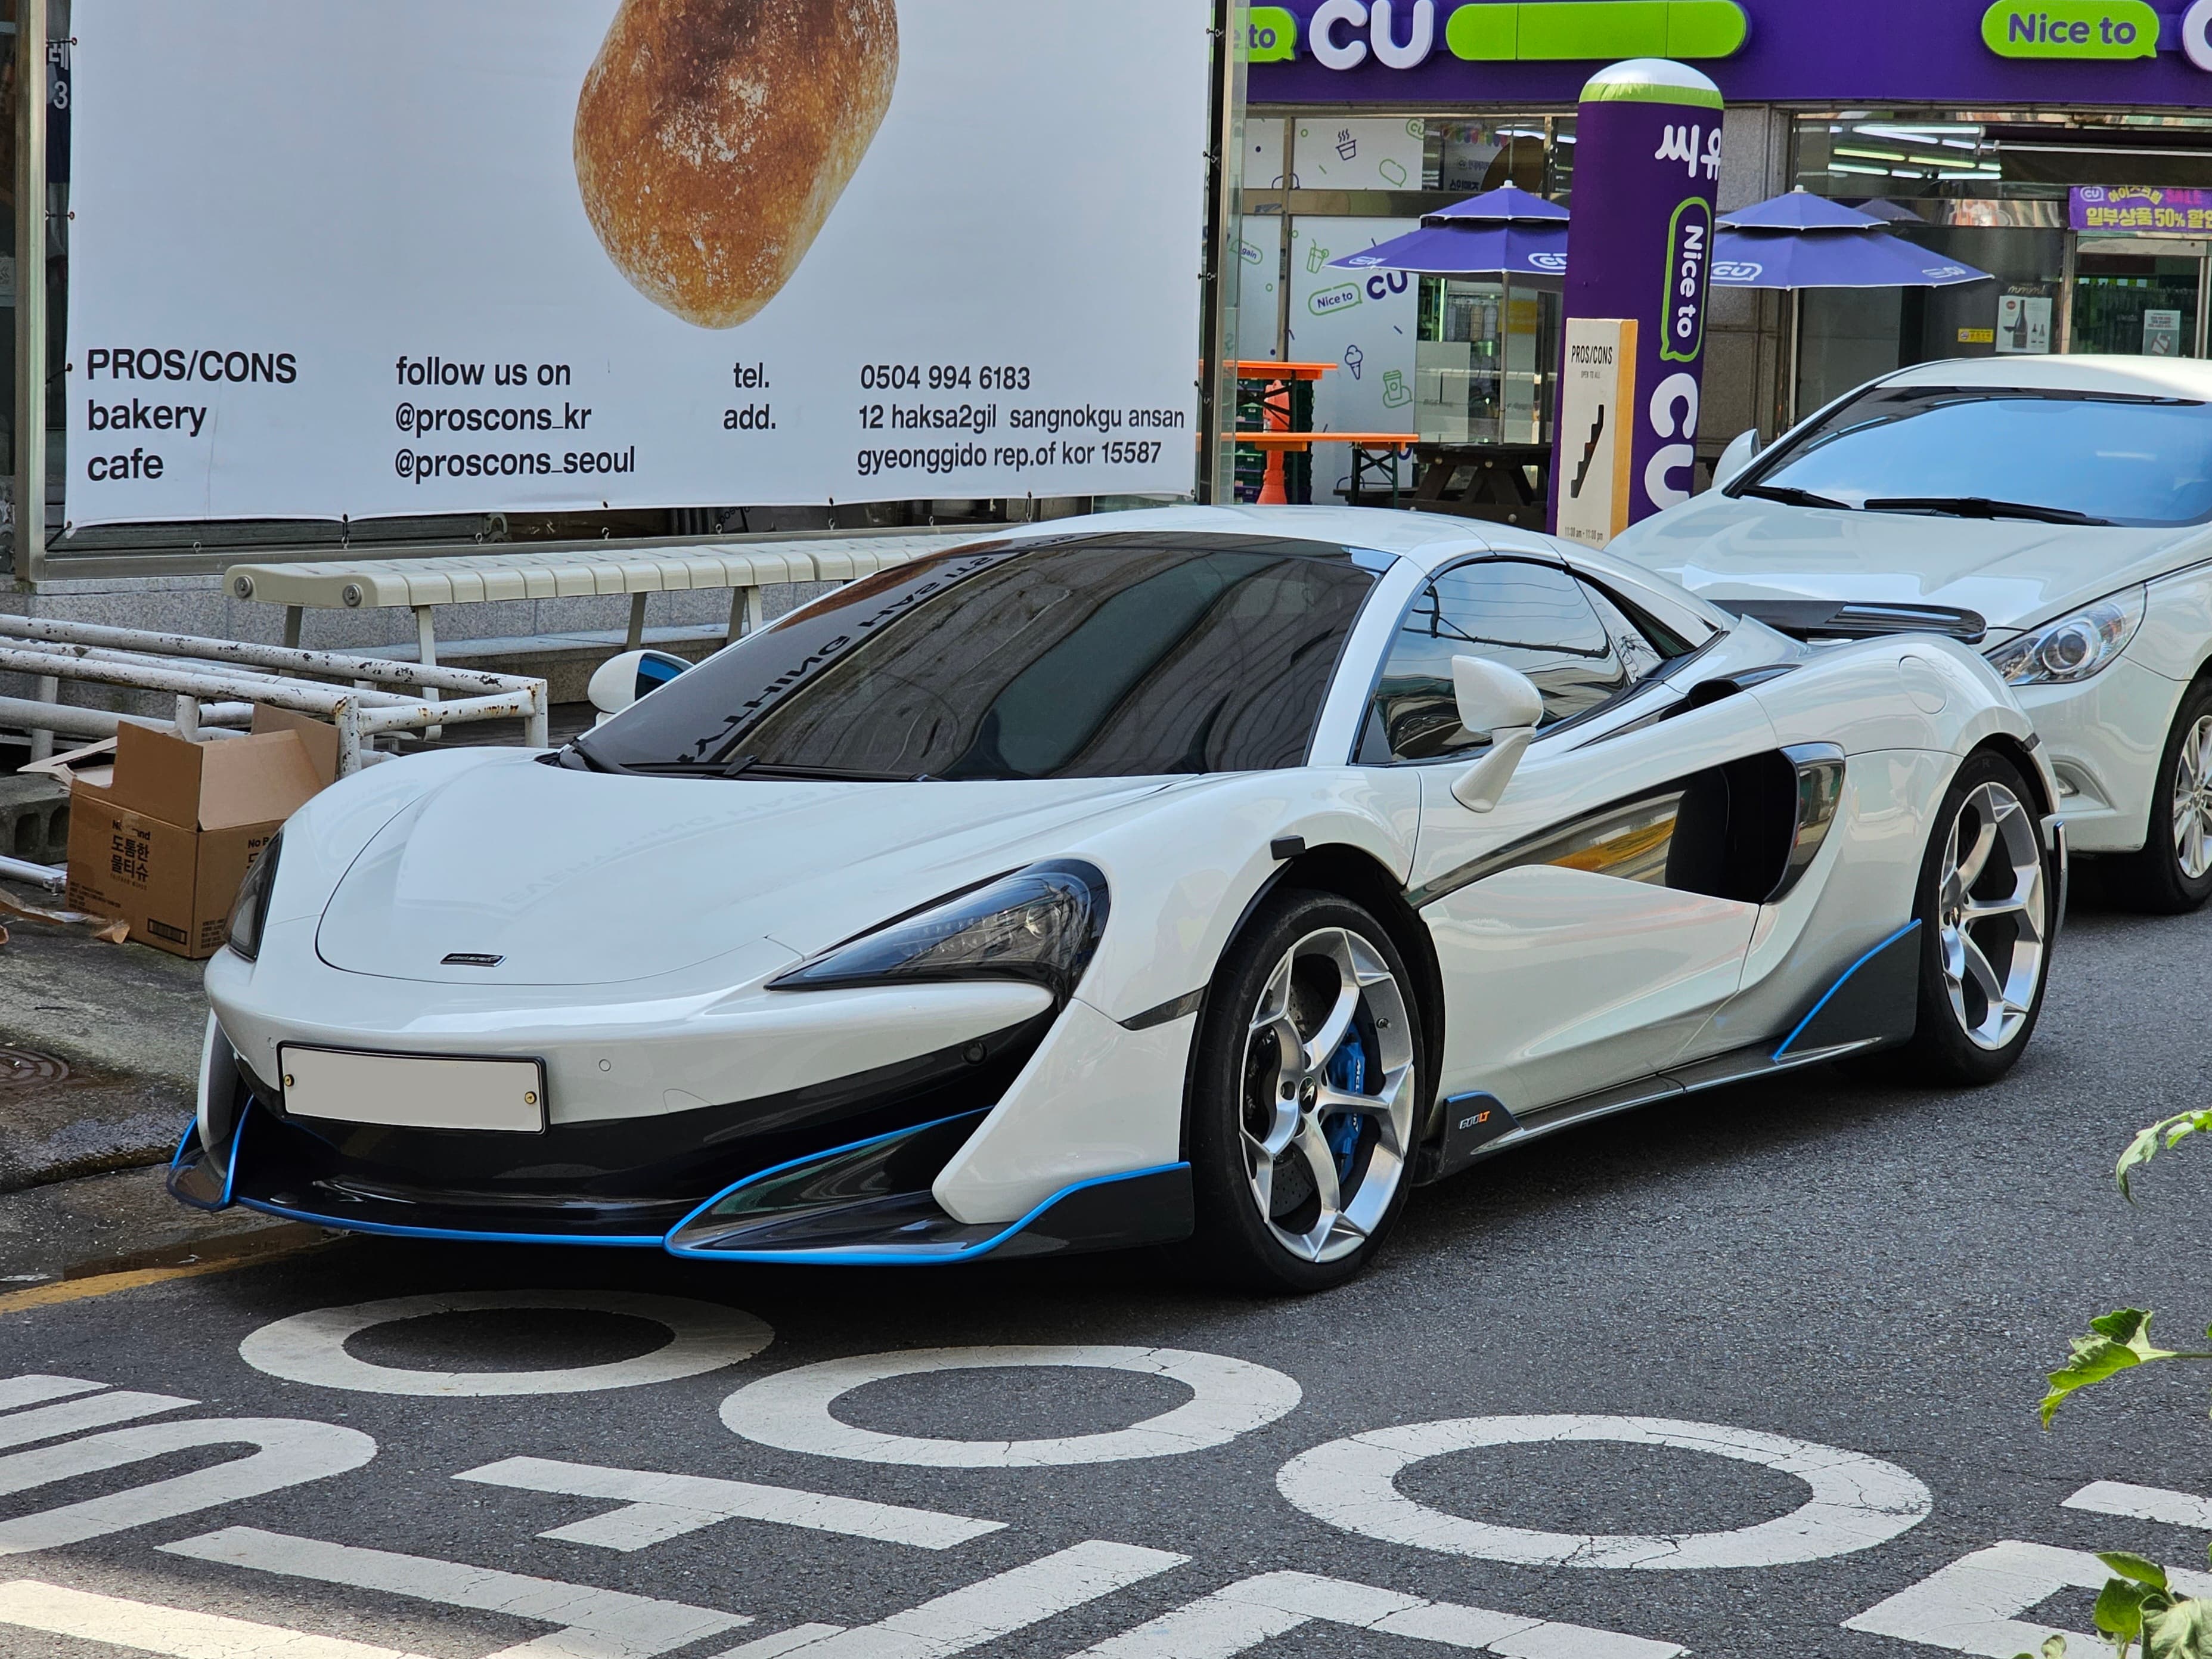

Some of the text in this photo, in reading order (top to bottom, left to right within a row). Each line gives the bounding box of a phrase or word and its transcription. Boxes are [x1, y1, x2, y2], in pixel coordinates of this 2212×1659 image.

[1248, 0, 1434, 70] to CU
[2008, 13, 2136, 45] Nice to
[53, 80, 69, 110] 3
[2086, 207, 2154, 228] 일부상품
[2155, 207, 2186, 228] 50%
[1240, 247, 1257, 259] gain
[1712, 263, 1752, 277] CU
[1316, 271, 1408, 309] Nice to CU
[88, 349, 297, 384] PROS/CONS
[1571, 345, 1613, 365] PROS/CONS
[1645, 225, 1704, 511] Nice to CU
[396, 356, 571, 386] follow us on
[734, 362, 770, 389] tel.
[861, 365, 1031, 390] 0504 994 6183
[89, 398, 207, 438] bakery
[396, 402, 592, 439] @proscons_kr
[724, 404, 777, 430] add.
[860, 404, 1185, 435] 12 haksa2gil sangnokgu ansan
[88, 448, 164, 482] cafe
[396, 446, 635, 485] @proscons_seoul
[858, 441, 1162, 476] gyeonggido rep.of kor 15587
[111, 834, 150, 863] 도톰한
[111, 854, 149, 883] 물티슈
[1459, 1111, 1490, 1130] 600LT
